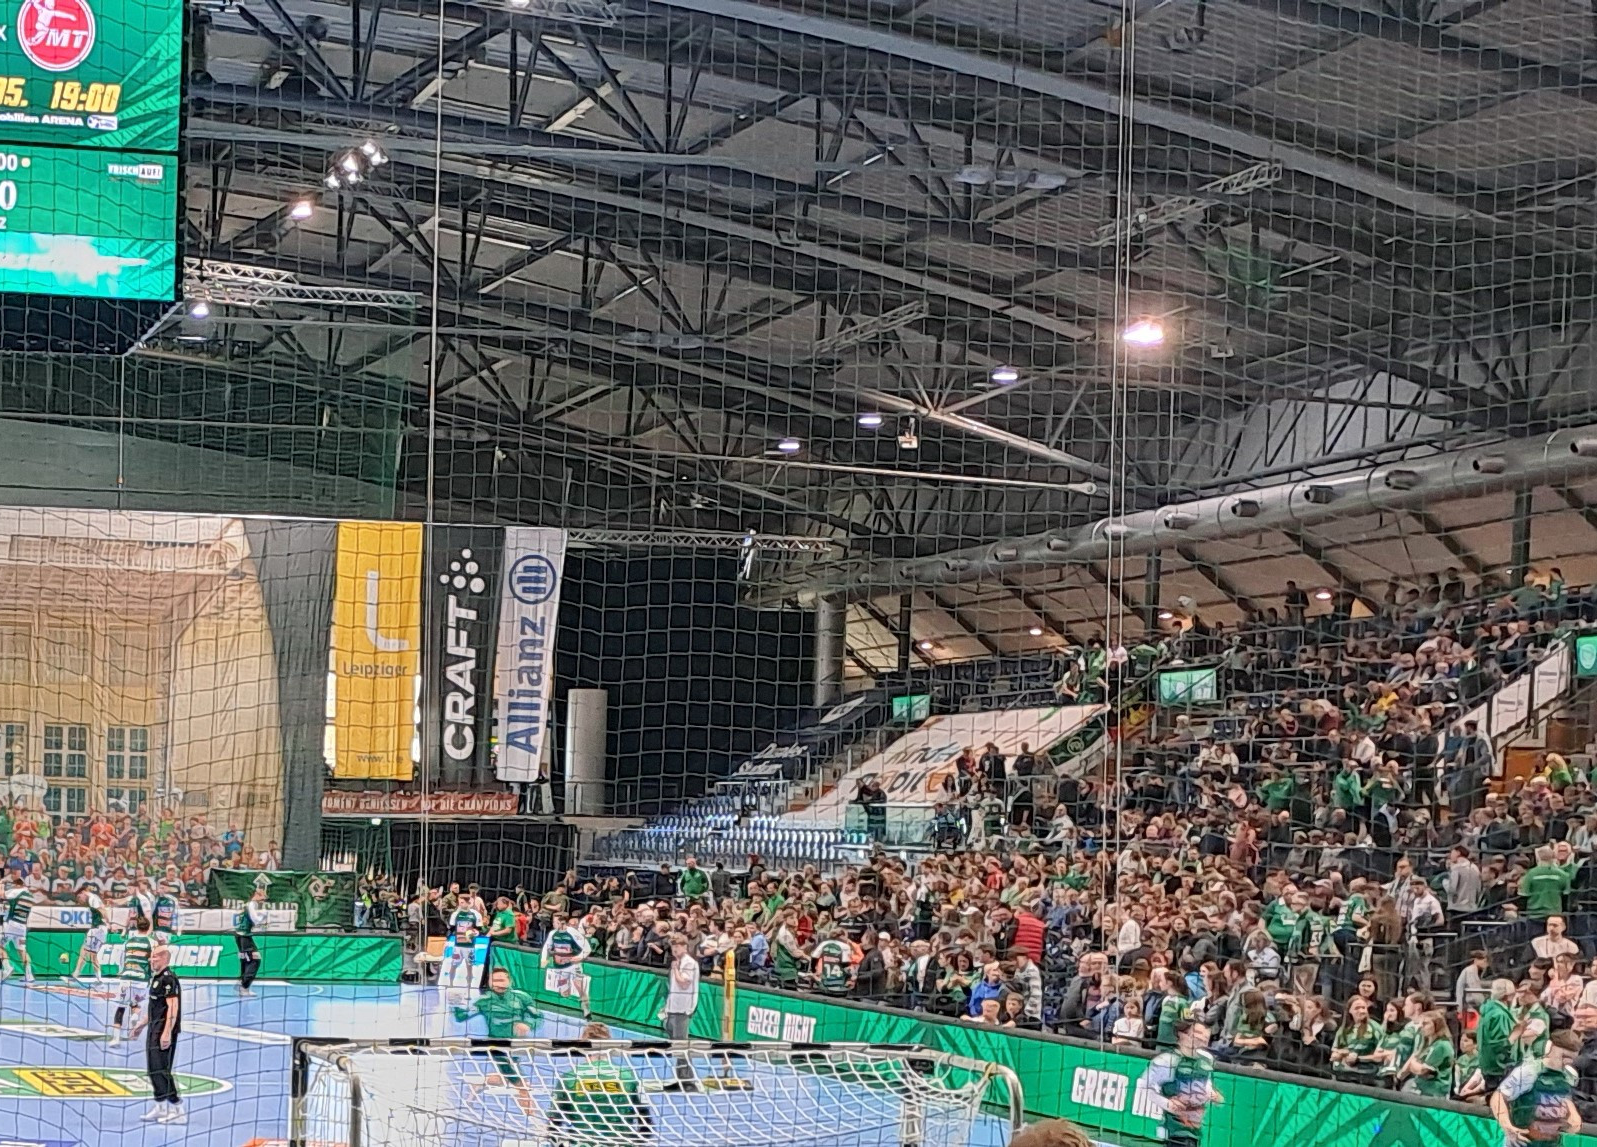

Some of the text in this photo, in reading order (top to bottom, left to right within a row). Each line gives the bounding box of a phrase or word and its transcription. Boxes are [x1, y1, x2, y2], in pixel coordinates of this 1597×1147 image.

[46, 29, 88, 48] MT
[50, 80, 121, 113] 19:00
[41, 115, 84, 127] ARENA
[343, 660, 408, 678] Leipziger
[443, 594, 478, 760] CRAFT
[505, 615, 545, 755] Allianz
